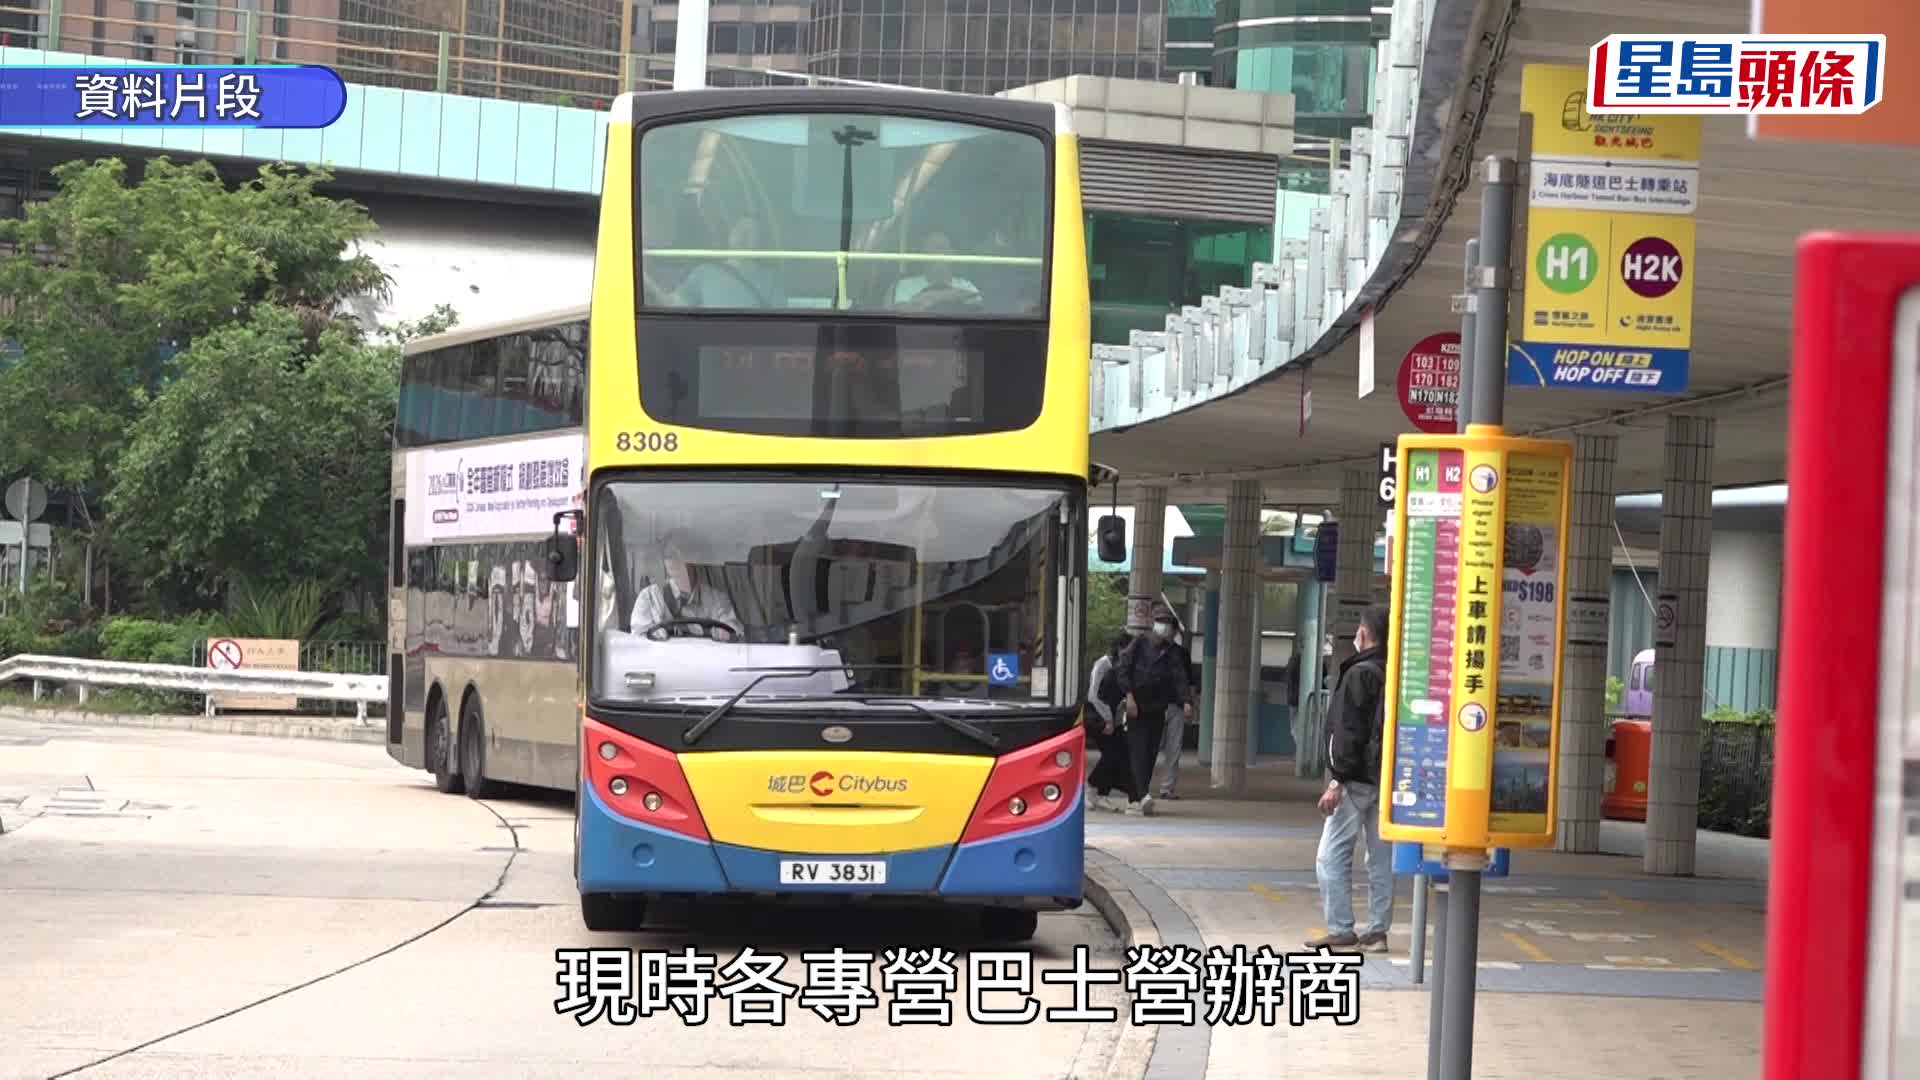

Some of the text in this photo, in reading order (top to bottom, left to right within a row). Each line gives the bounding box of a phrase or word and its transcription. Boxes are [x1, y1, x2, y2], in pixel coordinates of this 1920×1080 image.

[1594, 124, 1654, 135] SIGHTSEEING
[1543, 172, 1688, 194] 海底隧道巴士轉乘站
[1546, 246, 1589, 280] H1
[1624, 253, 1680, 282] H2K
[1416, 356, 1460, 370] 103 109
[1554, 349, 1618, 366] HOP ON
[1415, 373, 1458, 388] 170 182
[1554, 366, 1625, 383] HOP OFF
[1411, 390, 1434, 402] N170
[616, 432, 679, 453] 8308
[1415, 466, 1430, 482] H1
[1445, 466, 1461, 482] H2
[1518, 580, 1554, 603] $198
[1464, 576, 1489, 694] 上車請揚手
[768, 775, 806, 793] 城巴
[838, 775, 908, 793] Citybus
[792, 864, 875, 881] RV 3831
